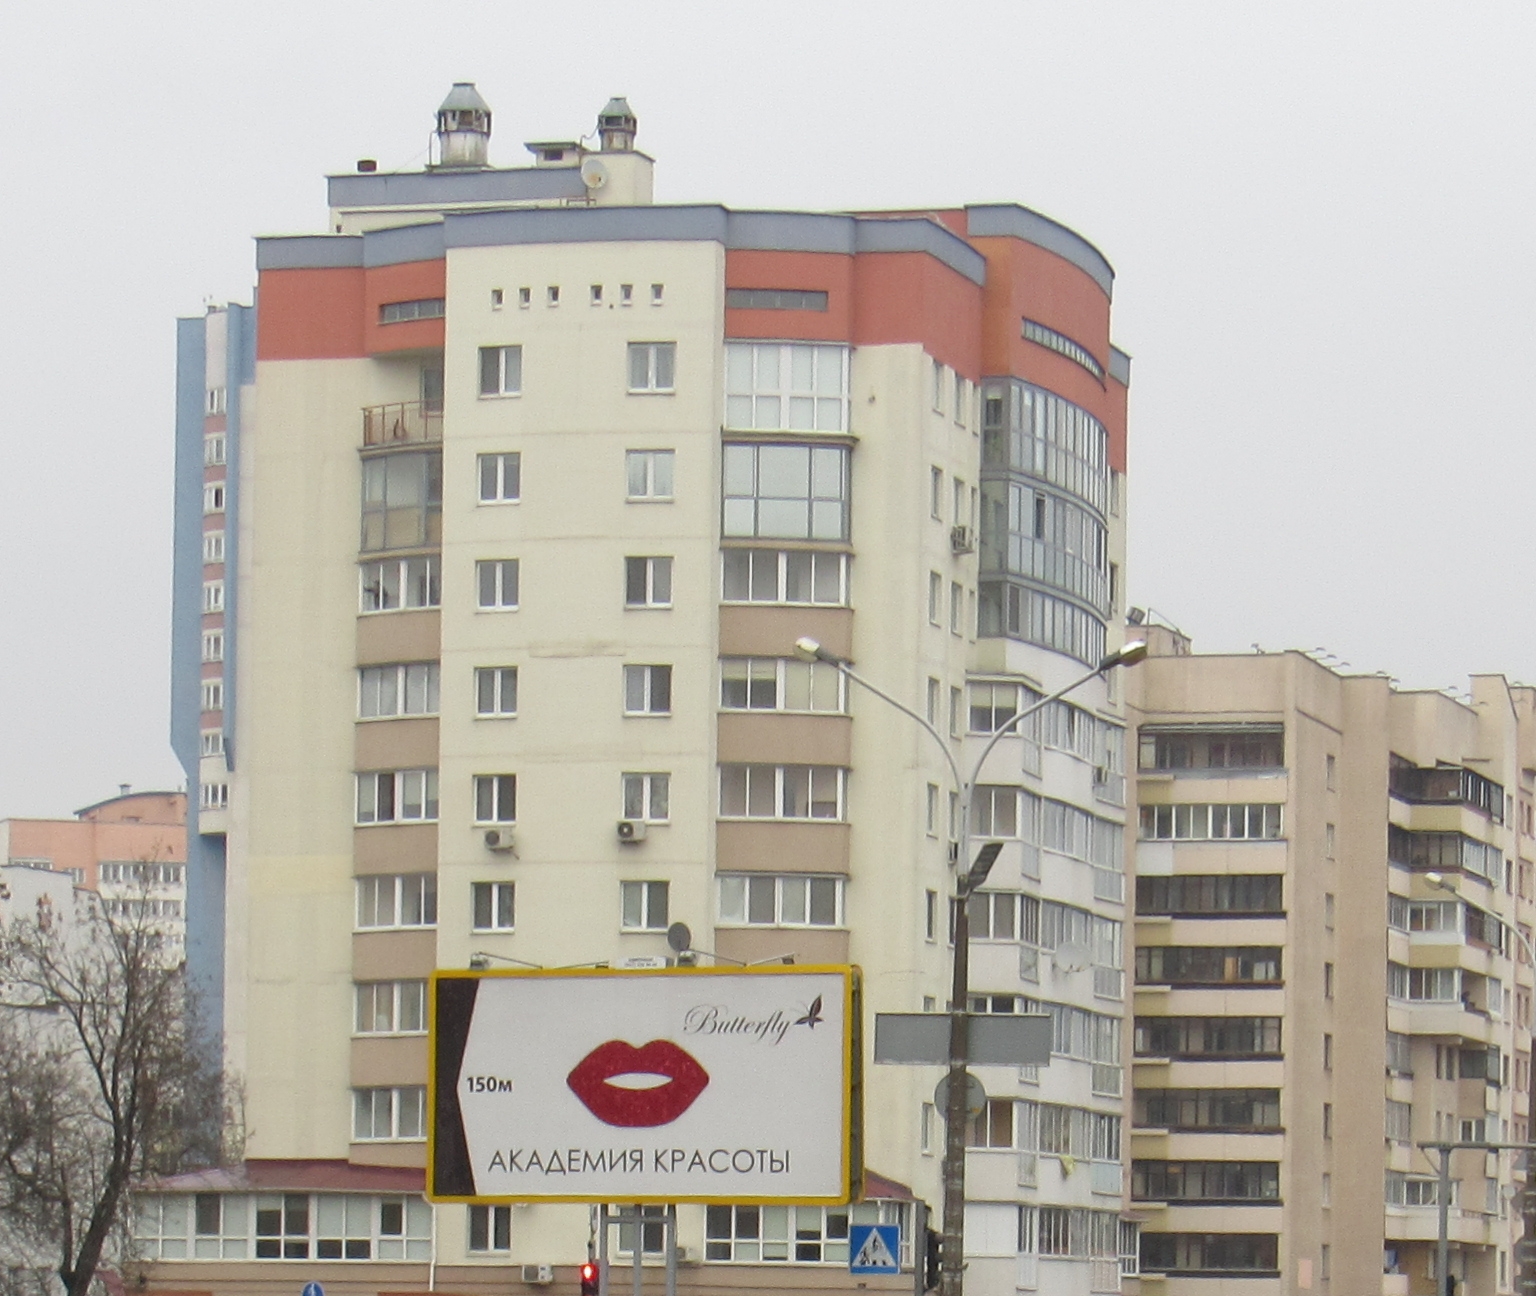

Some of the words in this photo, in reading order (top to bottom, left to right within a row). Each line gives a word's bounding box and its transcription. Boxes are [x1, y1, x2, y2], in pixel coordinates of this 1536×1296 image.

[682, 1004, 791, 1046] Butterfly
[466, 1076, 513, 1093] 150м
[487, 1149, 644, 1175] АКАДЕМИЯ
[653, 1149, 790, 1174] КРАСОТЫ
